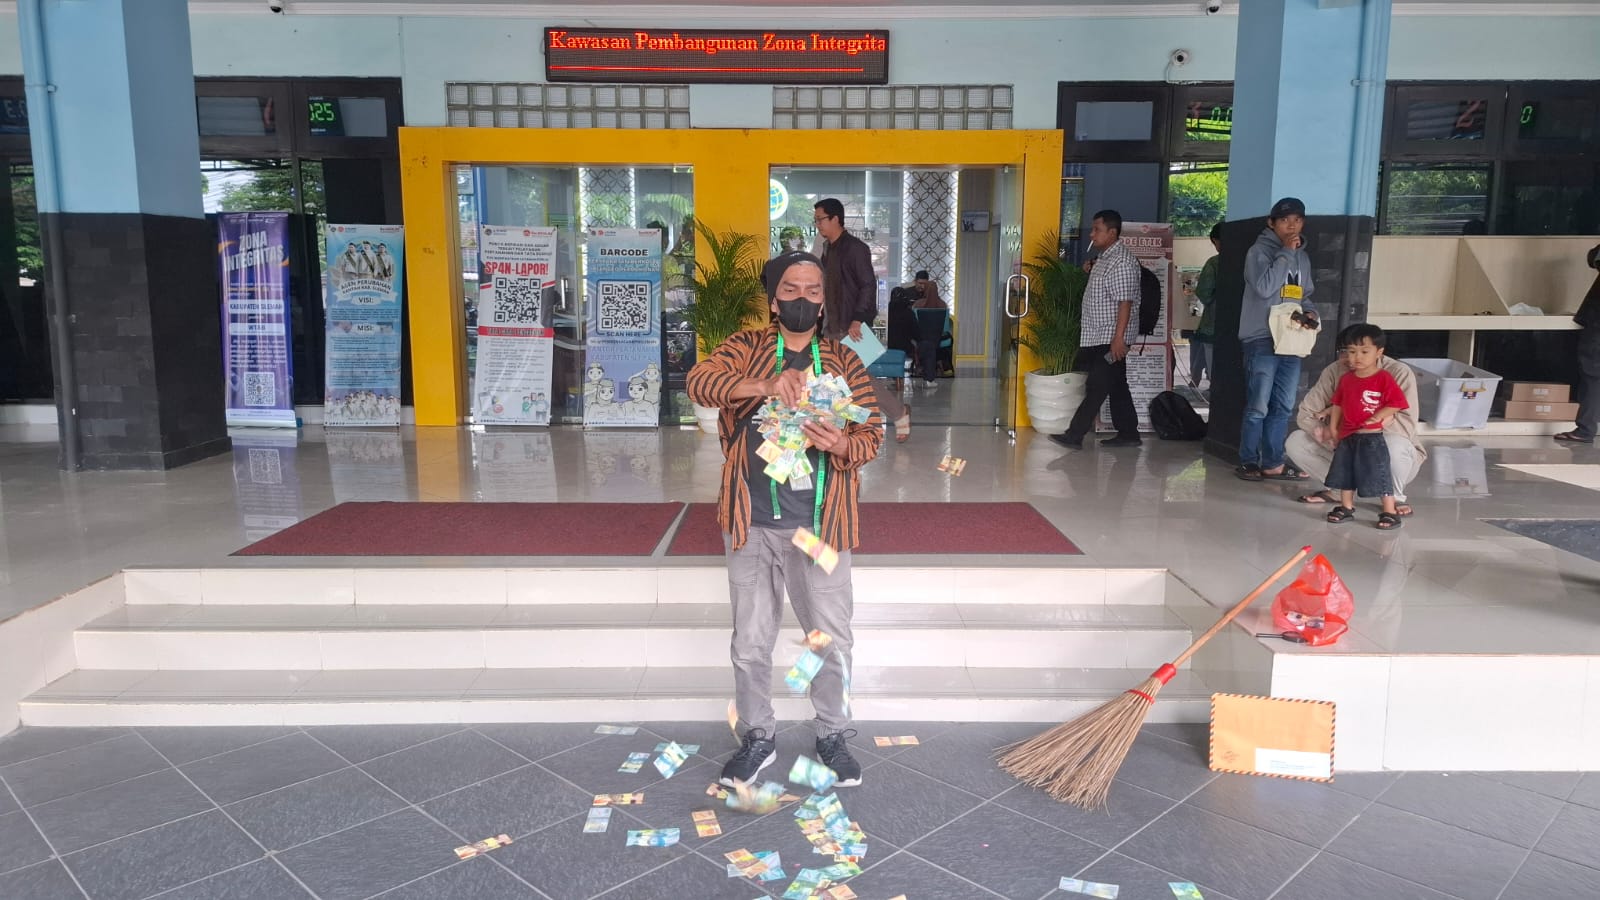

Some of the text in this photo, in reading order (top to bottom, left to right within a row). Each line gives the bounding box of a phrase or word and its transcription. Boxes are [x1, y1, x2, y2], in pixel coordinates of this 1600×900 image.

[549, 31, 886, 55] Kawasan Pembangunan Zona Integrita
[240, 231, 267, 253] ZONA
[1139, 237, 1162, 247] ETIK
[600, 248, 649, 257] BARCODE
[485, 262, 549, 276] SP4N-LAPOR!
[359, 296, 375, 304] VISI:
[357, 324, 375, 332] MISI:
